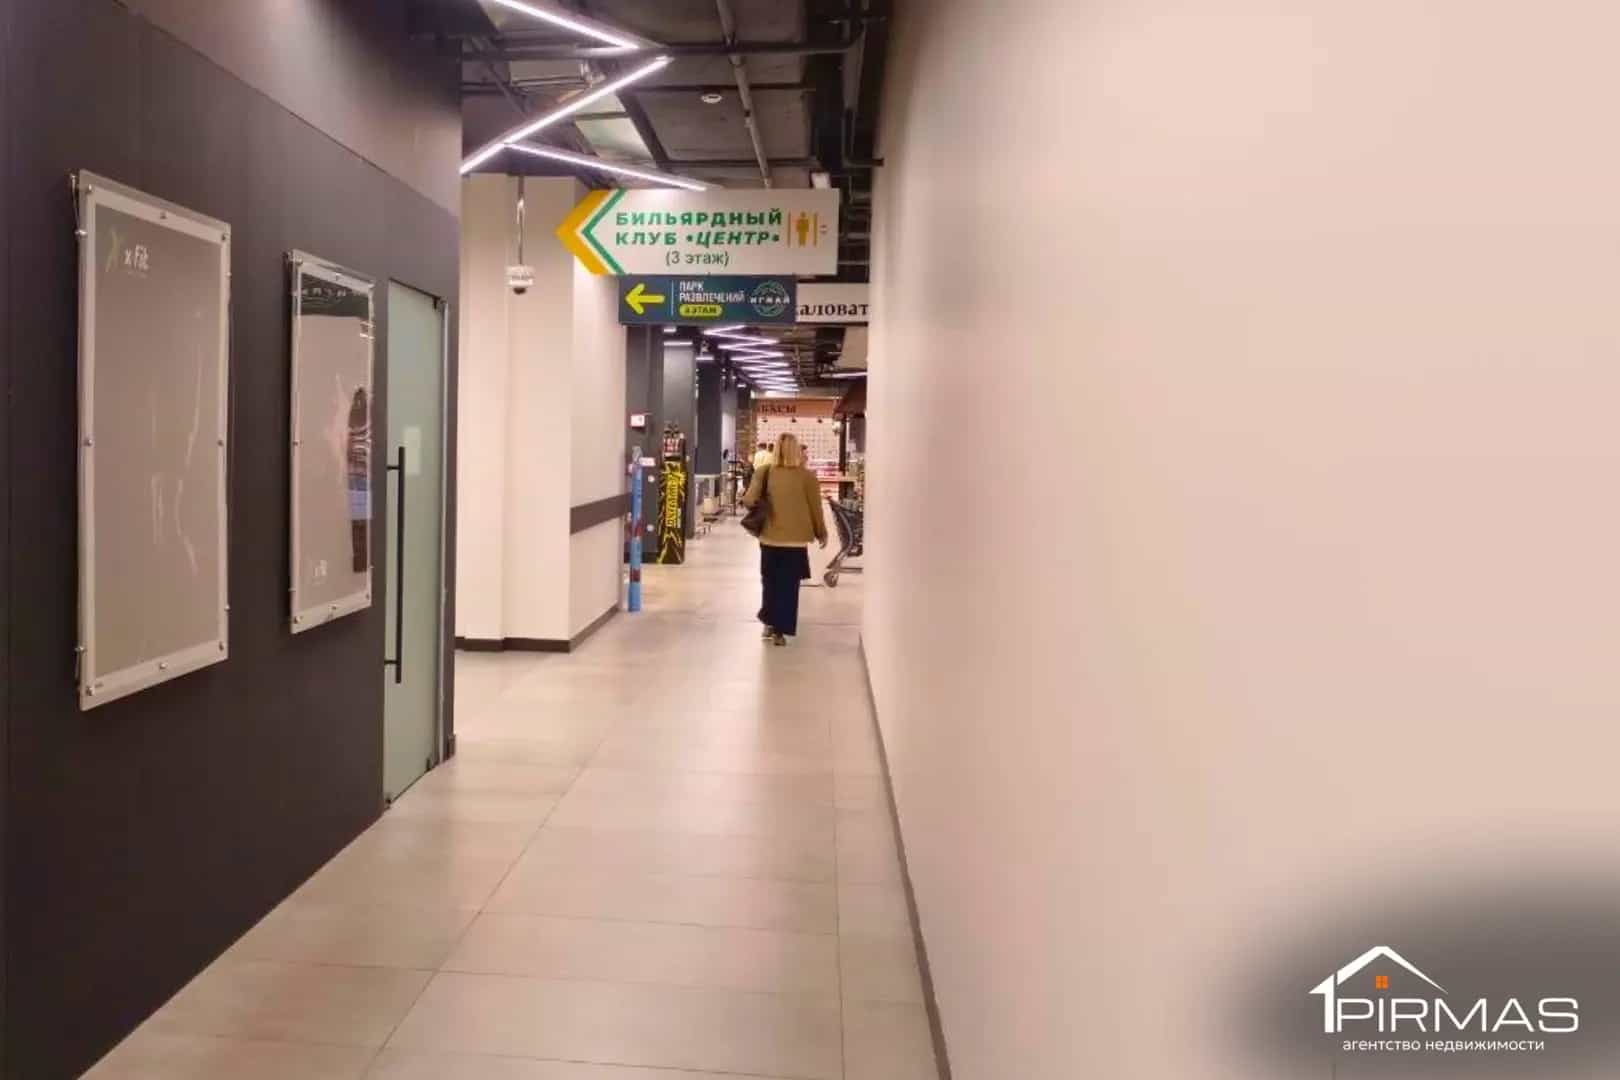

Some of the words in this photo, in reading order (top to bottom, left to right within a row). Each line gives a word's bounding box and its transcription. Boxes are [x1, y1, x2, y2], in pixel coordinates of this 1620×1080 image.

[616, 208, 782, 226] БИЛЬЯРДНЫЙ
[616, 231, 677, 245] КЛУБ
[666, 251, 680, 266] (3
[686, 251, 730, 266] этаж)
[680, 281, 704, 291] ПАРК
[680, 290, 745, 303] РАЗВЛЕЧЕНИЙ
